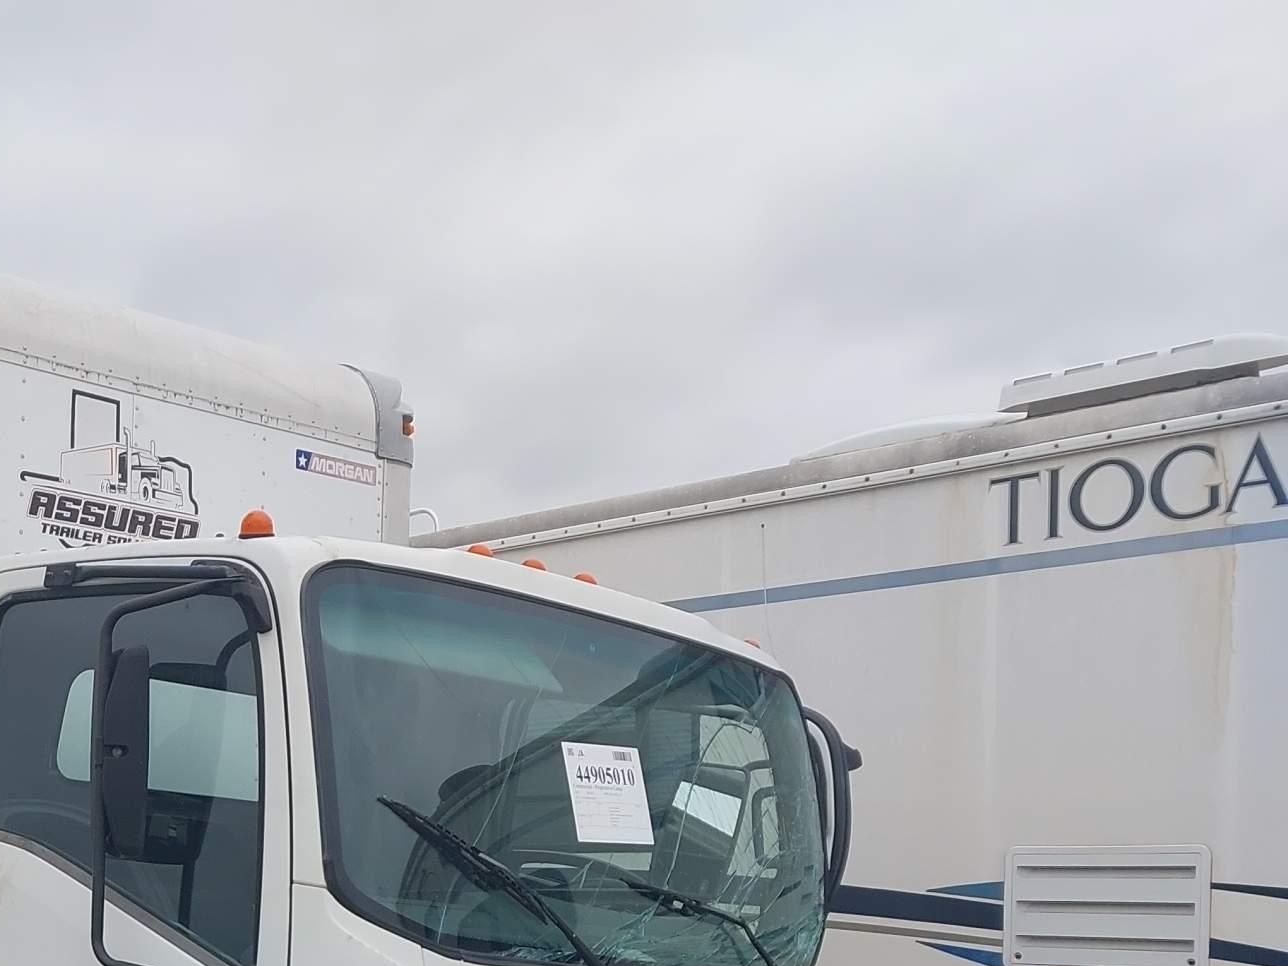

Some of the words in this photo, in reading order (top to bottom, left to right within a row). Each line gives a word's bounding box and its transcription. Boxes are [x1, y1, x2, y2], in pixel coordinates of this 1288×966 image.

[311, 457, 376, 483] MORGAN
[987, 431, 1288, 546] TIOGA
[28, 490, 200, 540] ASSURED
[40, 522, 103, 544] TRAILER
[575, 764, 635, 786] 44905010
